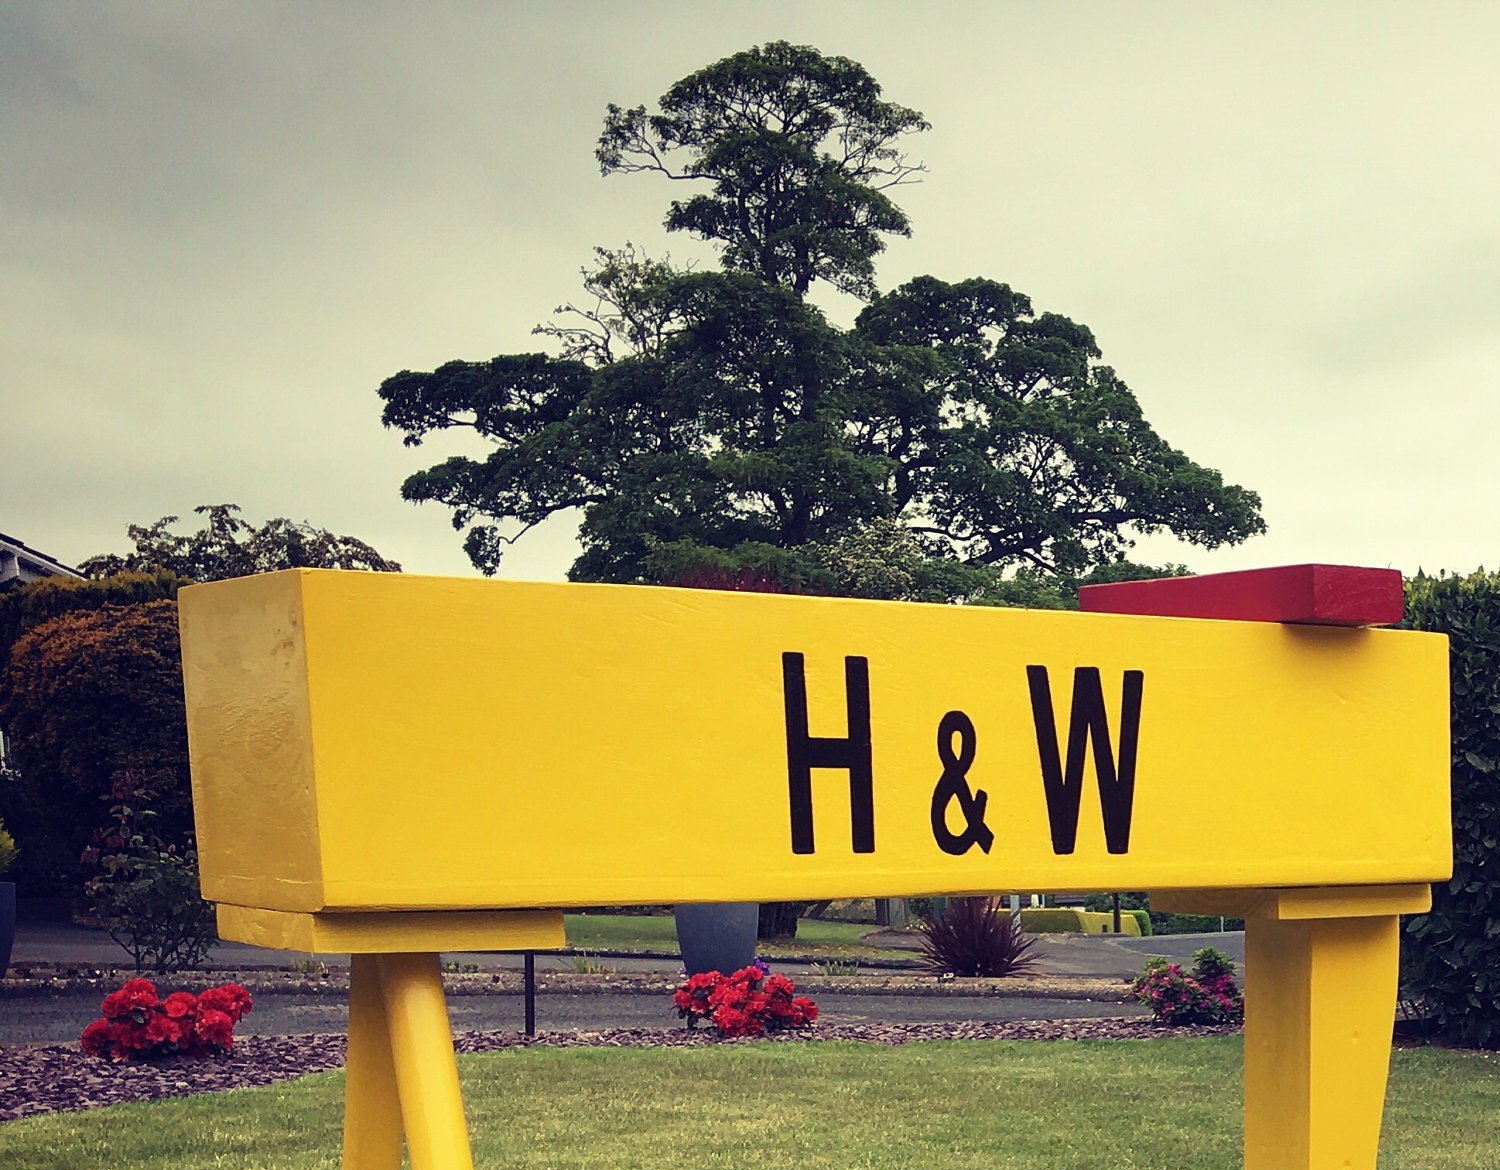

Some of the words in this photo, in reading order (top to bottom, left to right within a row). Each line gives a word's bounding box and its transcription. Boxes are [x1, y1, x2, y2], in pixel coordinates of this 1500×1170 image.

[782, 651, 875, 855] H
[931, 710, 995, 856] &
[1026, 664, 1144, 855] W
